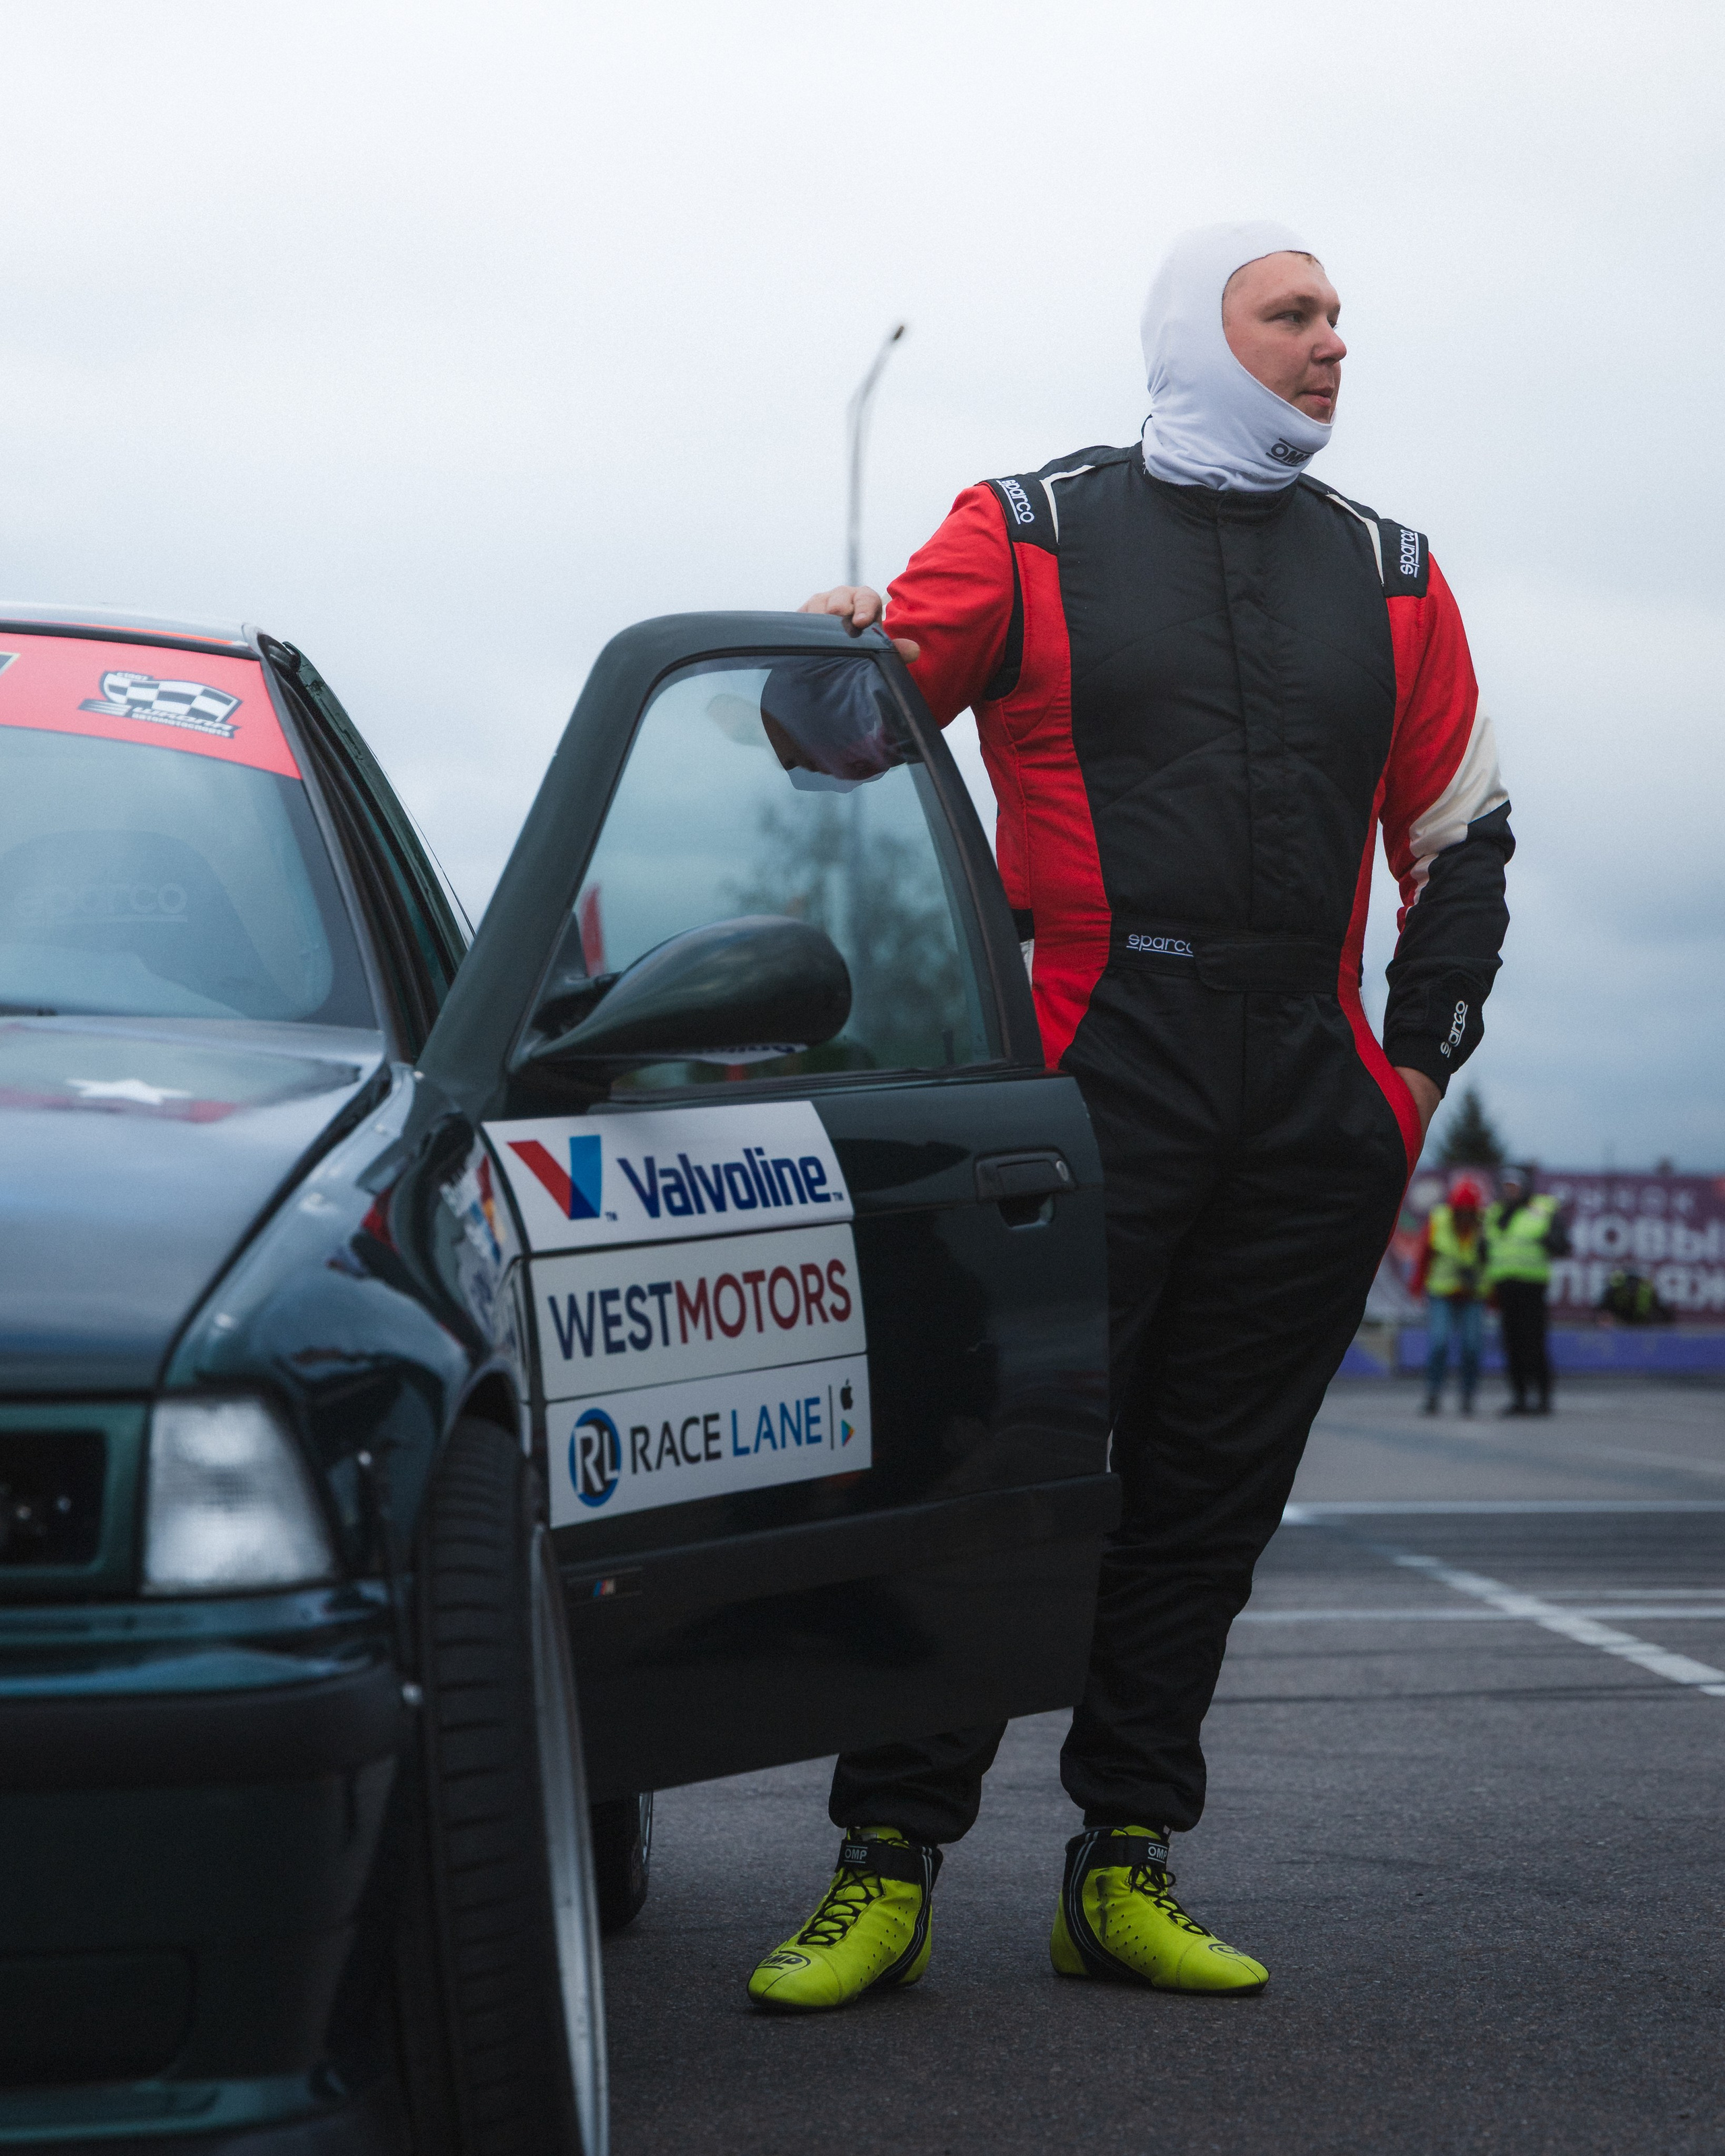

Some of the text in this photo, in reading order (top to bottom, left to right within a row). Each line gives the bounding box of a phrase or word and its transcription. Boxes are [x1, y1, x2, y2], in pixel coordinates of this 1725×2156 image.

[998, 479, 1035, 523] sparco
[1400, 529, 1420, 575] sparco
[1440, 1001, 1466, 1055] sarco
[617, 1147, 832, 1218] Valvoline
[548, 1259, 852, 1360] WESTMOTORS
[630, 1413, 722, 1474] RACE
[731, 1397, 822, 1457] LANE
[844, 1848, 867, 1860] OMP
[1148, 1846, 1168, 1860] OMP
